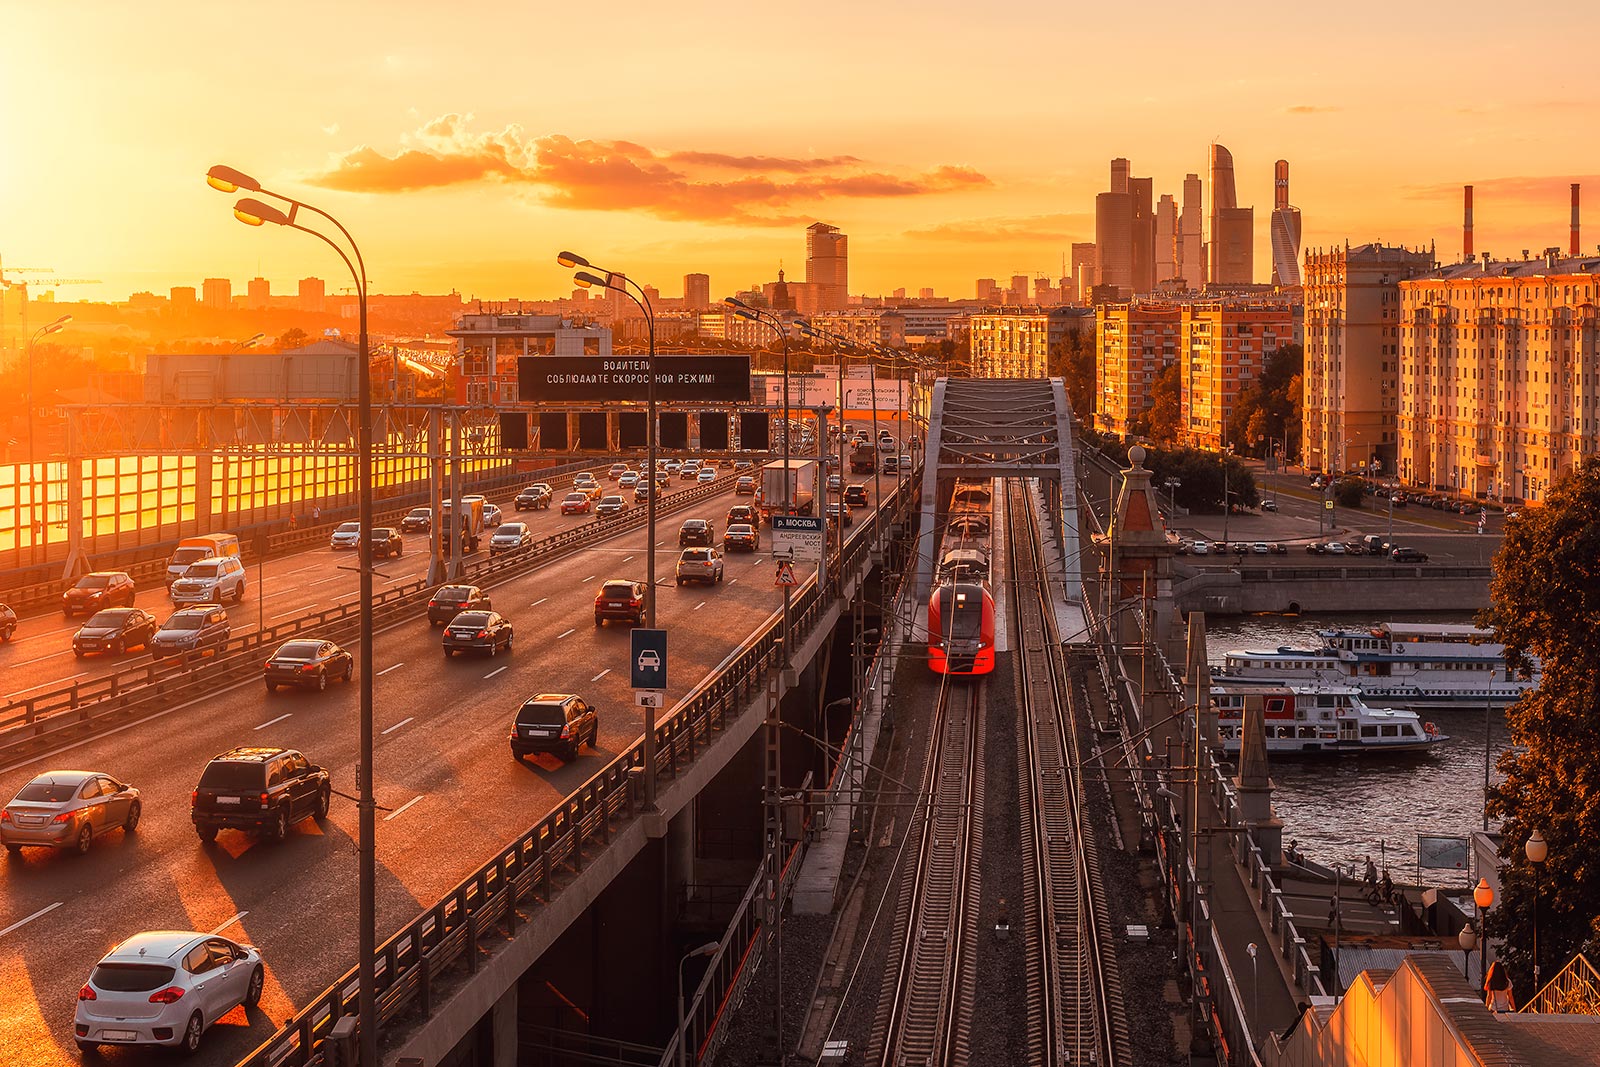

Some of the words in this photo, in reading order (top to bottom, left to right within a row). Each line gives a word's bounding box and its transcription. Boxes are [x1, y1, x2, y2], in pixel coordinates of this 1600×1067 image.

[603, 361, 650, 371] ВОДИТЕЛИ
[546, 374, 609, 384] СОБЛЮДАЙТЕ
[612, 374, 674, 384] СКОРОСНОЙ
[678, 374, 715, 384] РЕЖИМ!
[786, 519, 816, 528] МОСКВА
